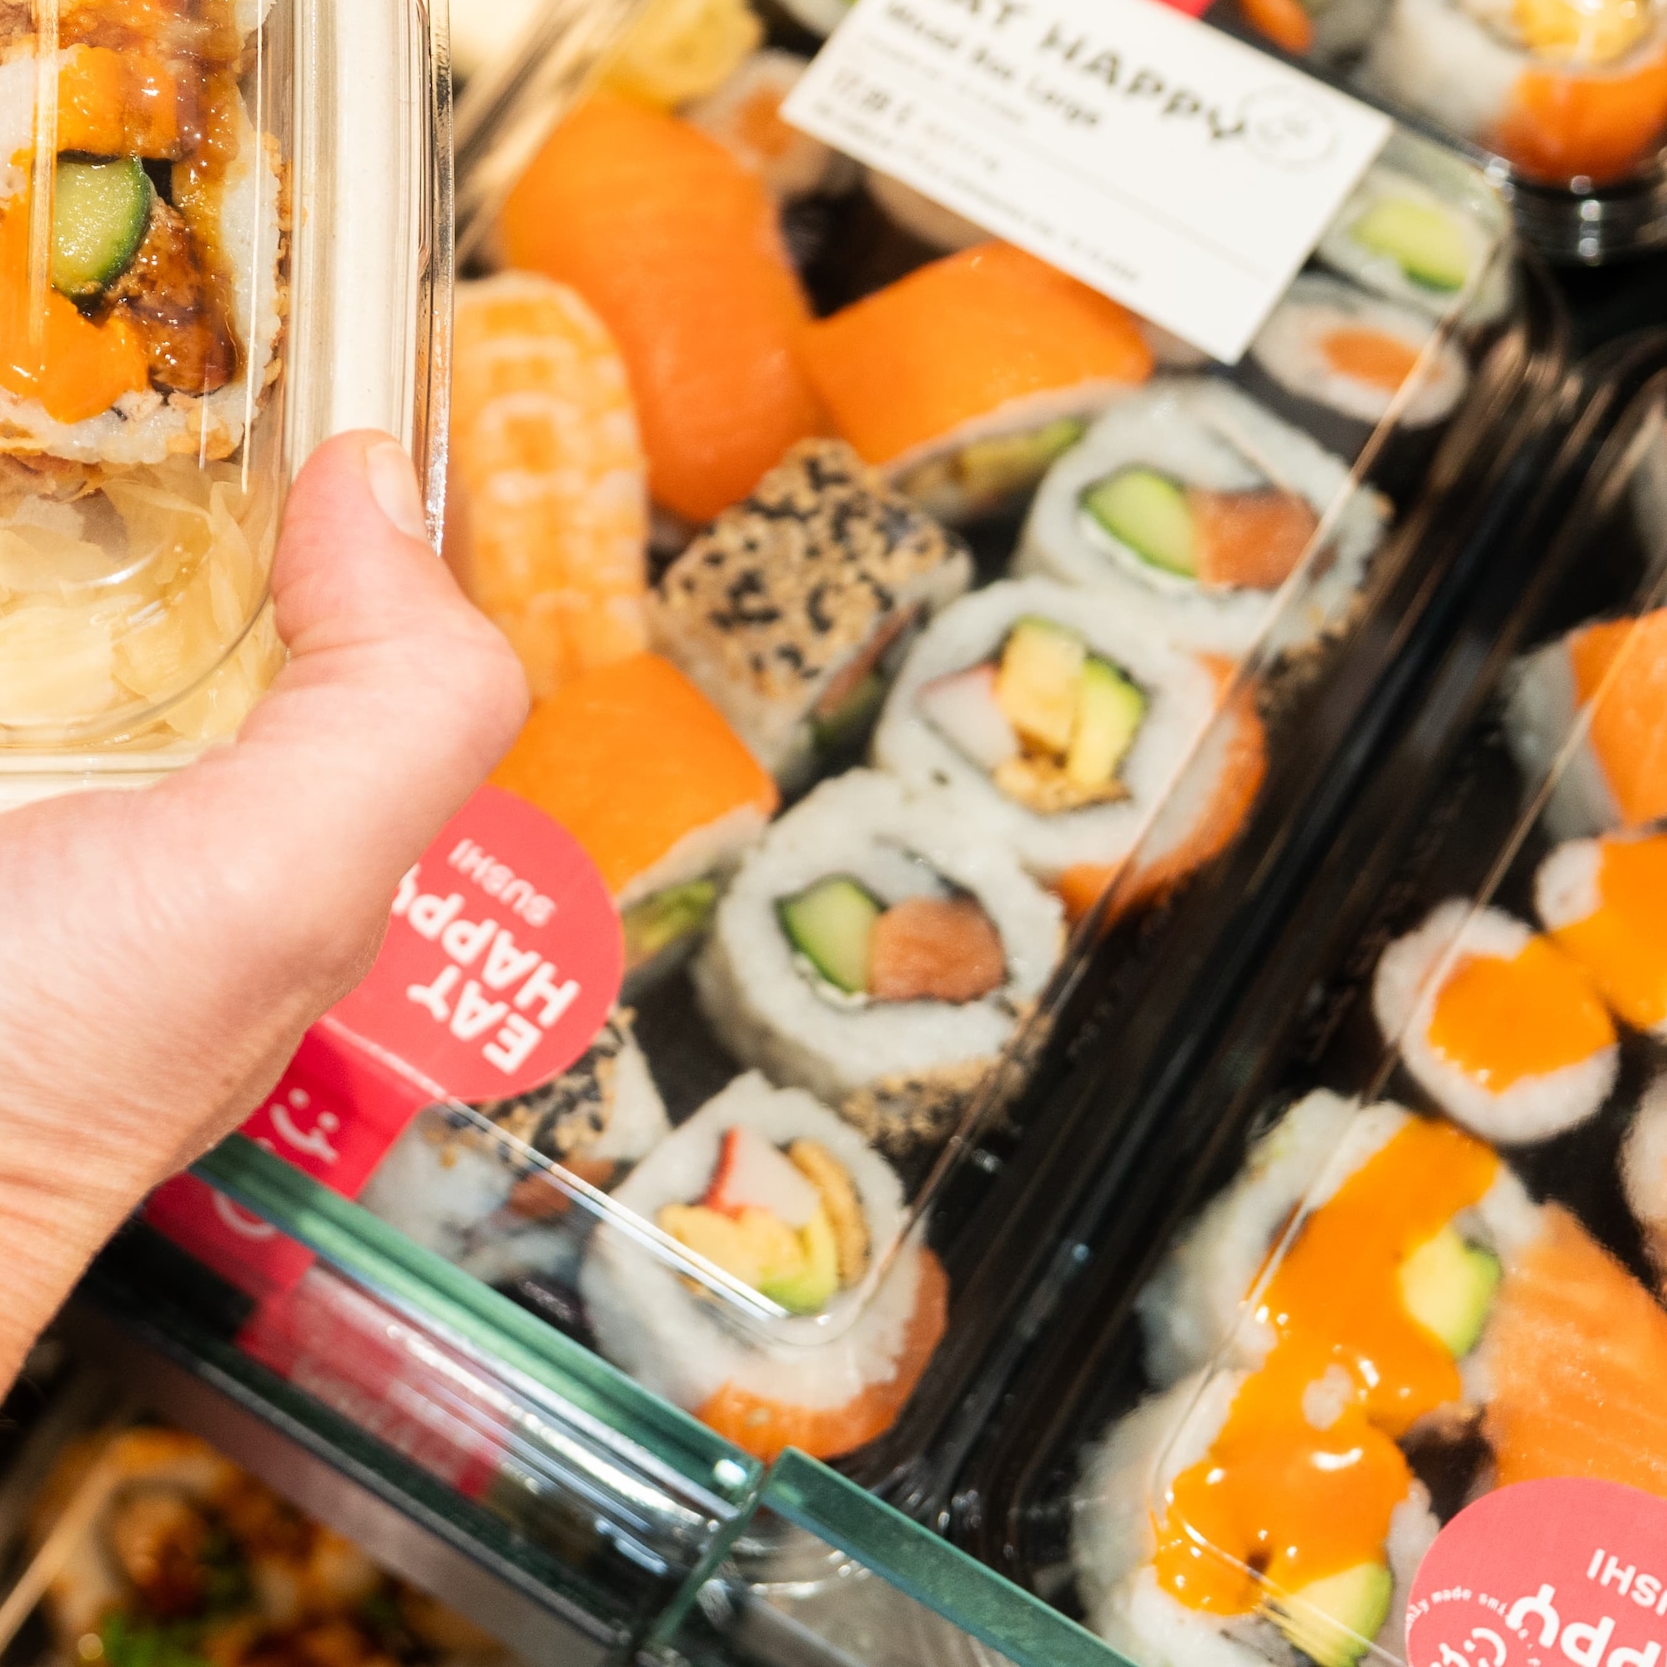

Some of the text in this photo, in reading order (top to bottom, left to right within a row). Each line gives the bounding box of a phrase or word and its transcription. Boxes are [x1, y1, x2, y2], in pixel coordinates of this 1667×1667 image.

[1038, 21, 1246, 145] HAPPY
[447, 838, 557, 928] SUSHI
[406, 964, 543, 1075] EAT
[1505, 1584, 1661, 1667] PPY
[1586, 1548, 1667, 1617] SHI
